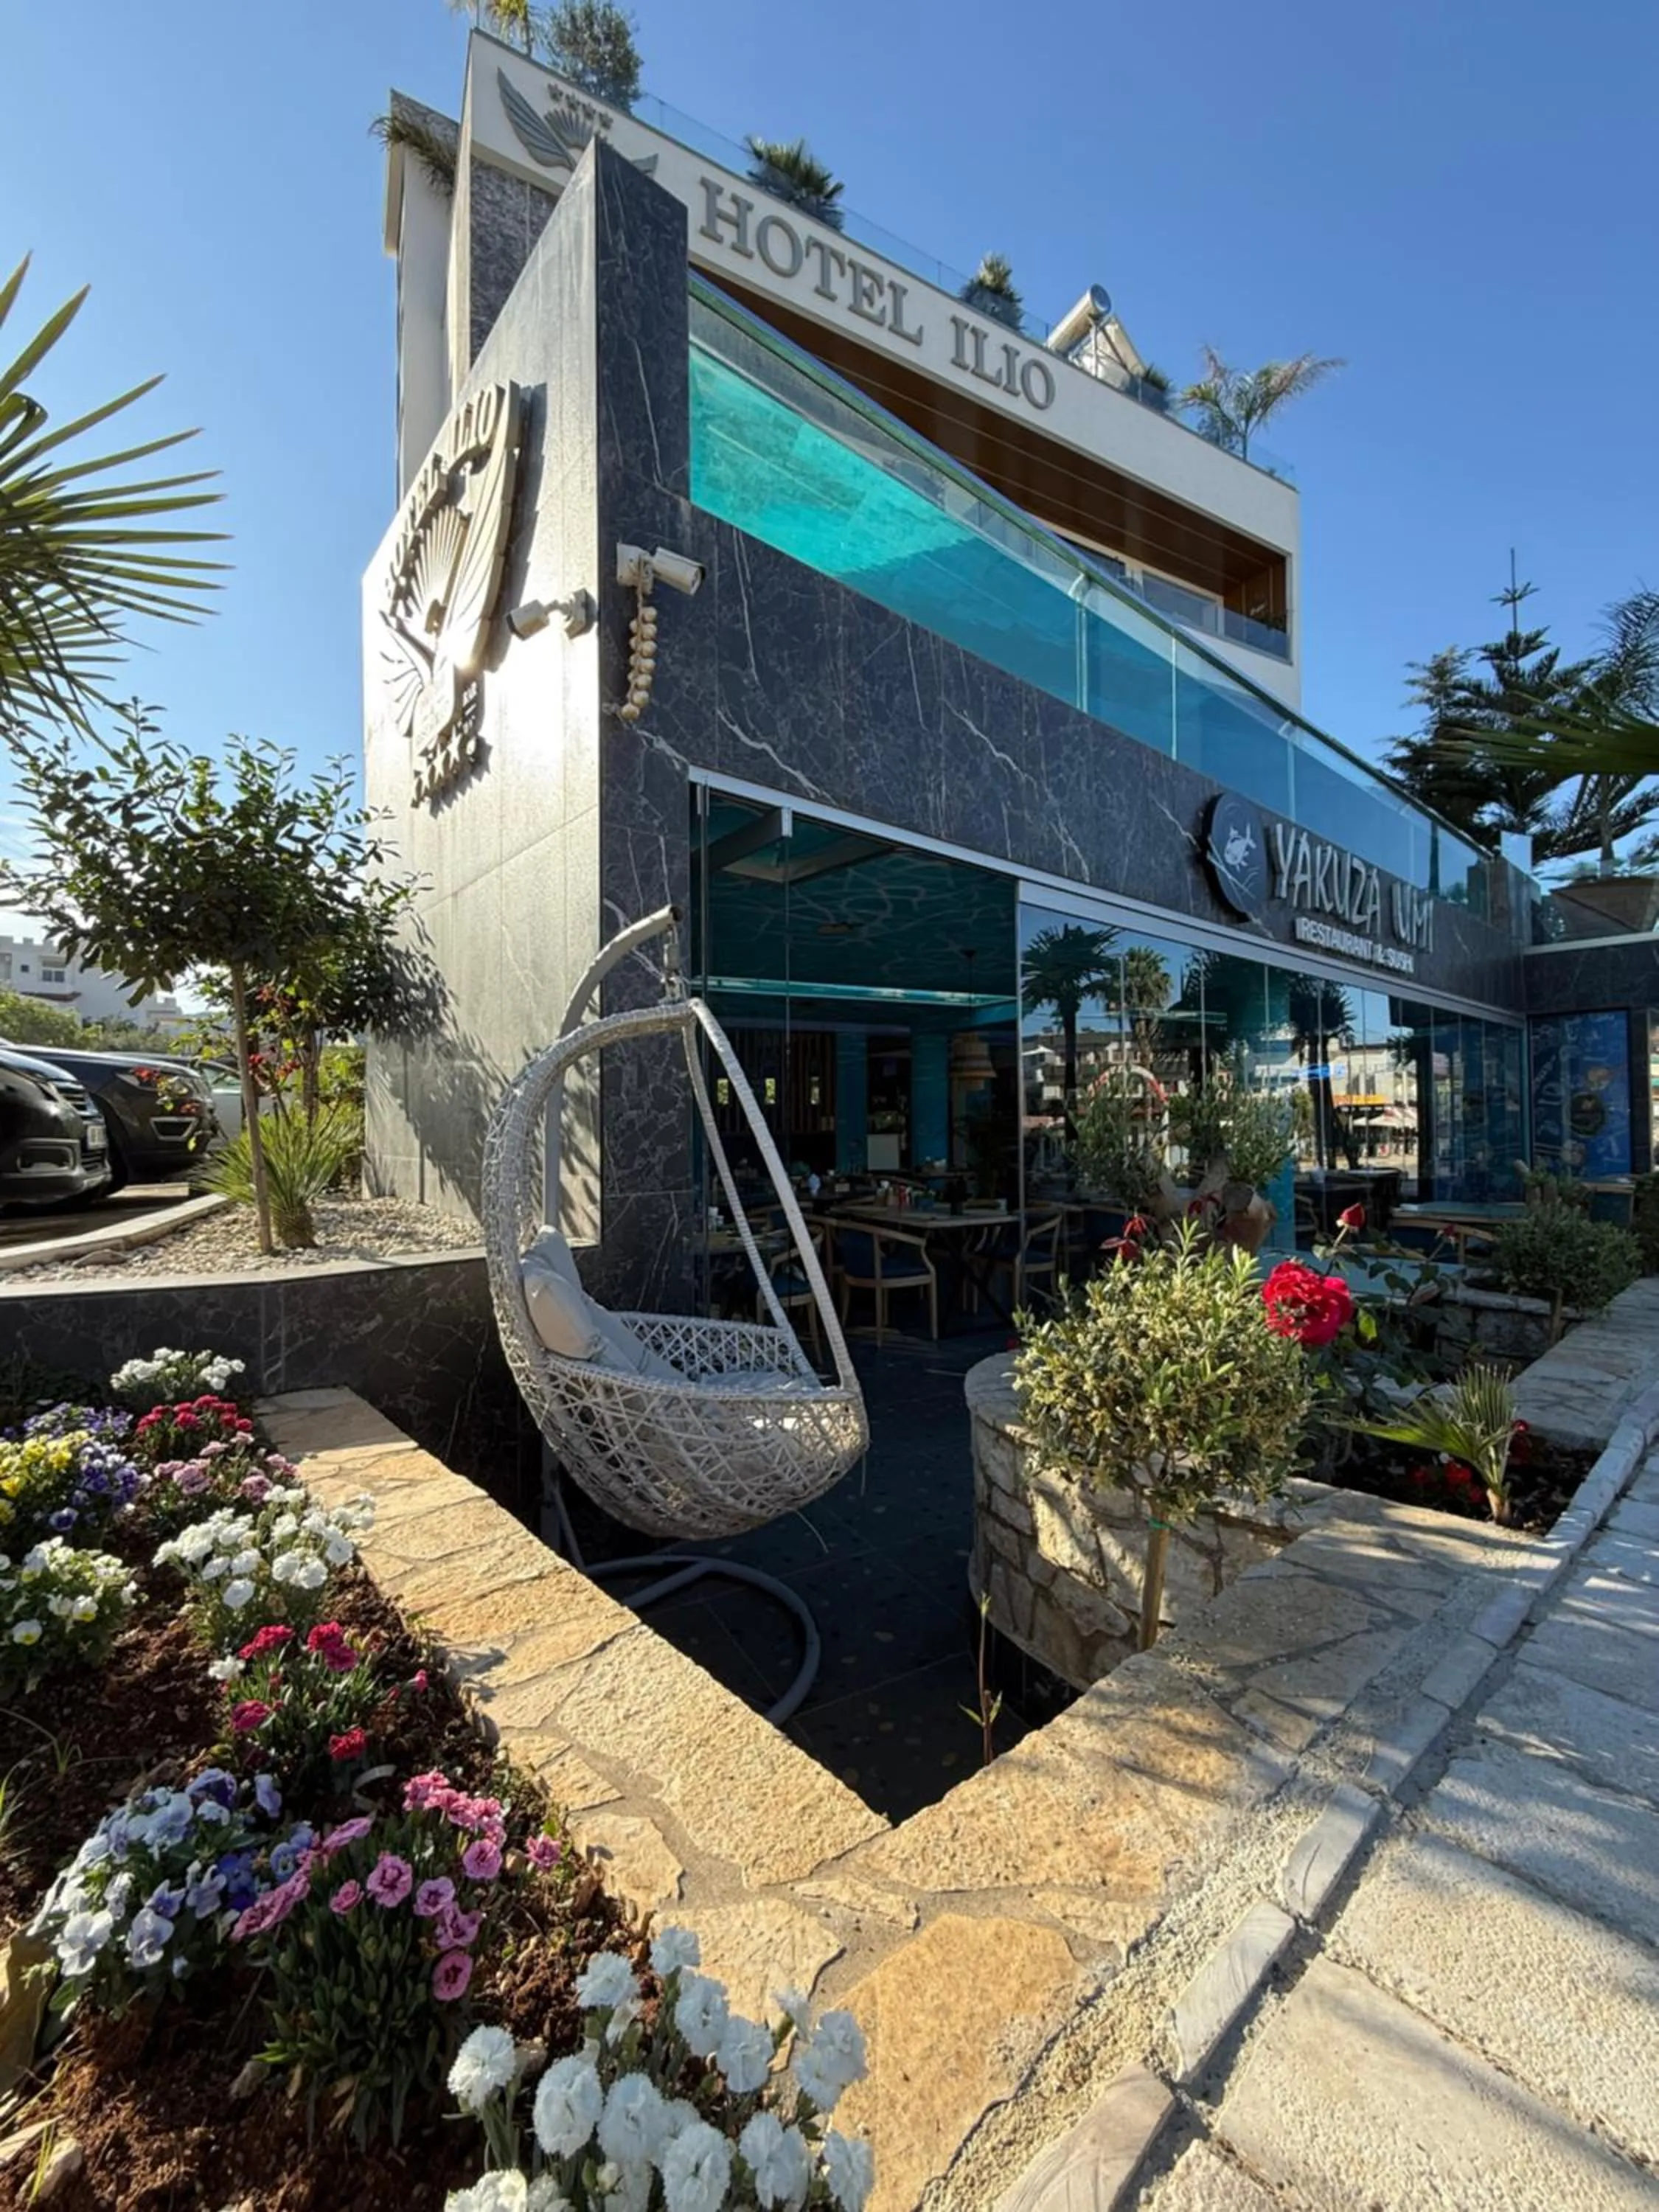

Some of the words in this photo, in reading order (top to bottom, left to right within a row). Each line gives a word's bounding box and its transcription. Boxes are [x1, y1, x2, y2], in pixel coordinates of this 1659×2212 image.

[700, 175, 924, 346] HOTEL
[950, 314, 1056, 411] ILIO
[1275, 823, 1382, 936] YAKUZA
[1391, 882, 1434, 953] UMI
[1295, 917, 1374, 961] RESTAURANT
